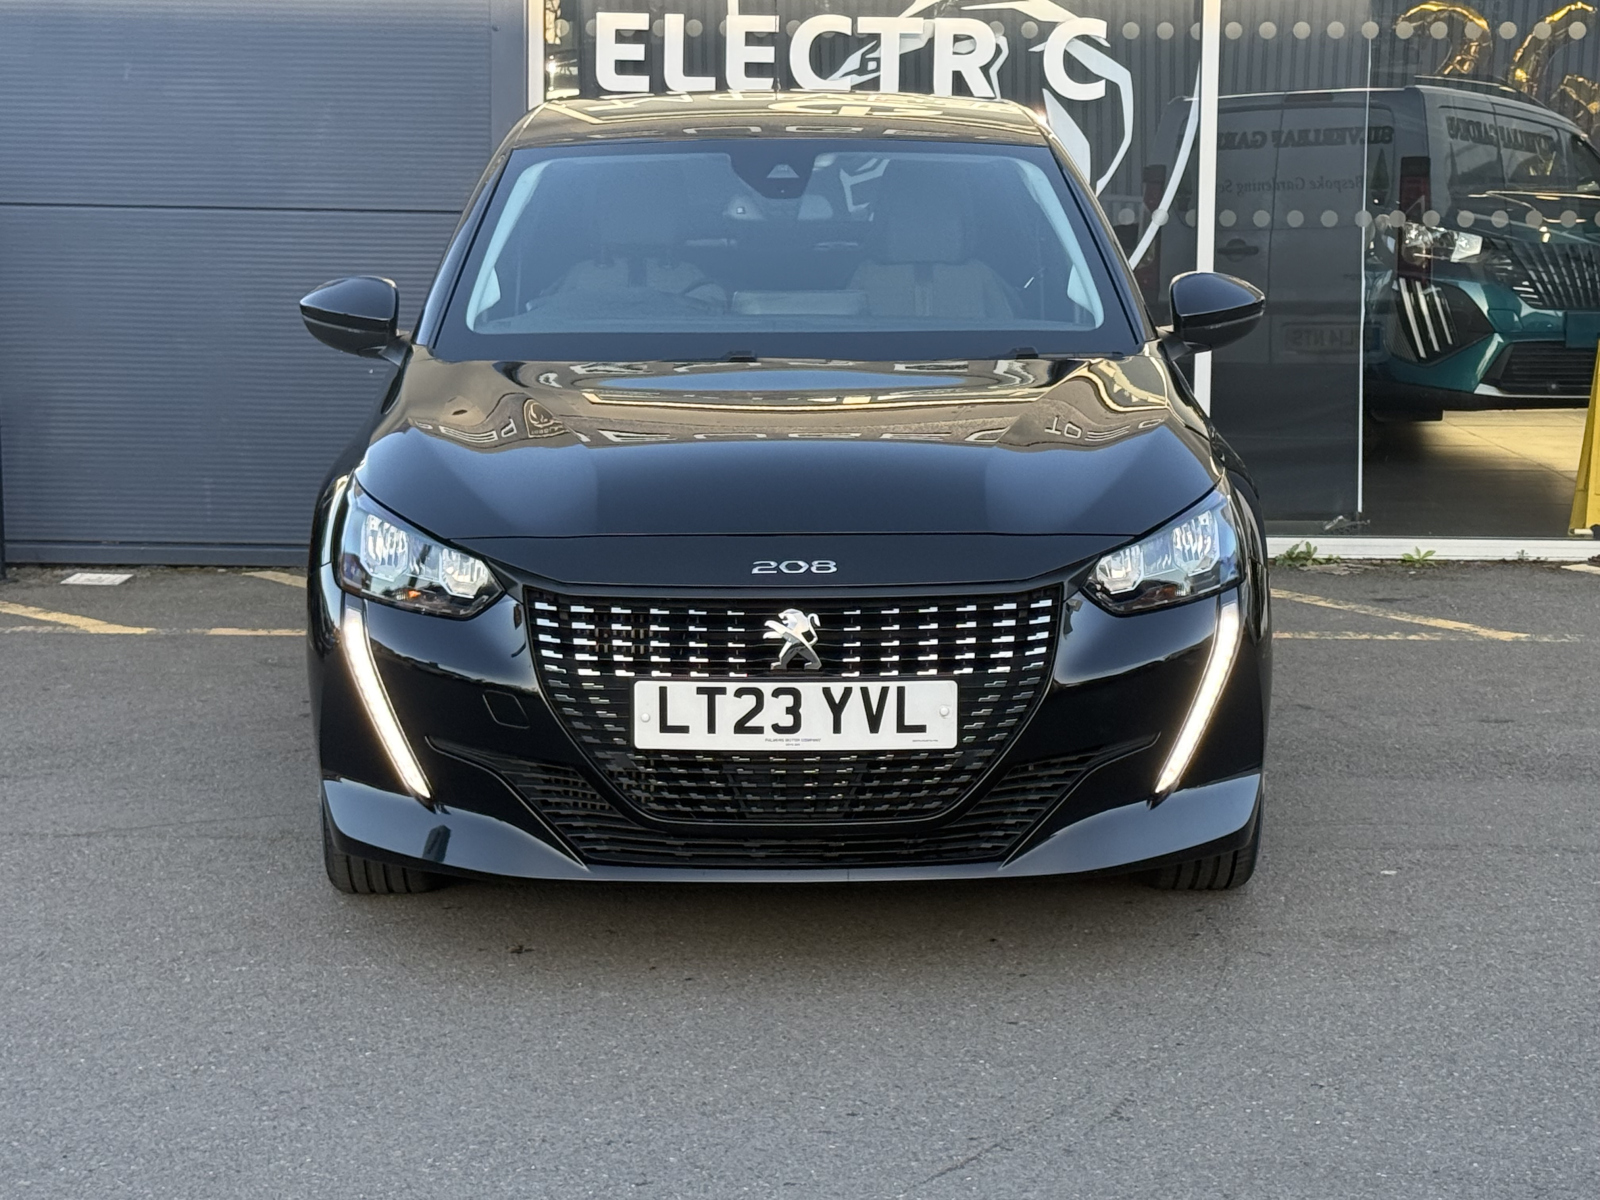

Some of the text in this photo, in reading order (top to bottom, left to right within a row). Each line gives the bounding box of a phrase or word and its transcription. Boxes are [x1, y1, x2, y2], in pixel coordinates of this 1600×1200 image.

[751, 559, 838, 575] 208
[658, 686, 927, 735] LT23 YVL
